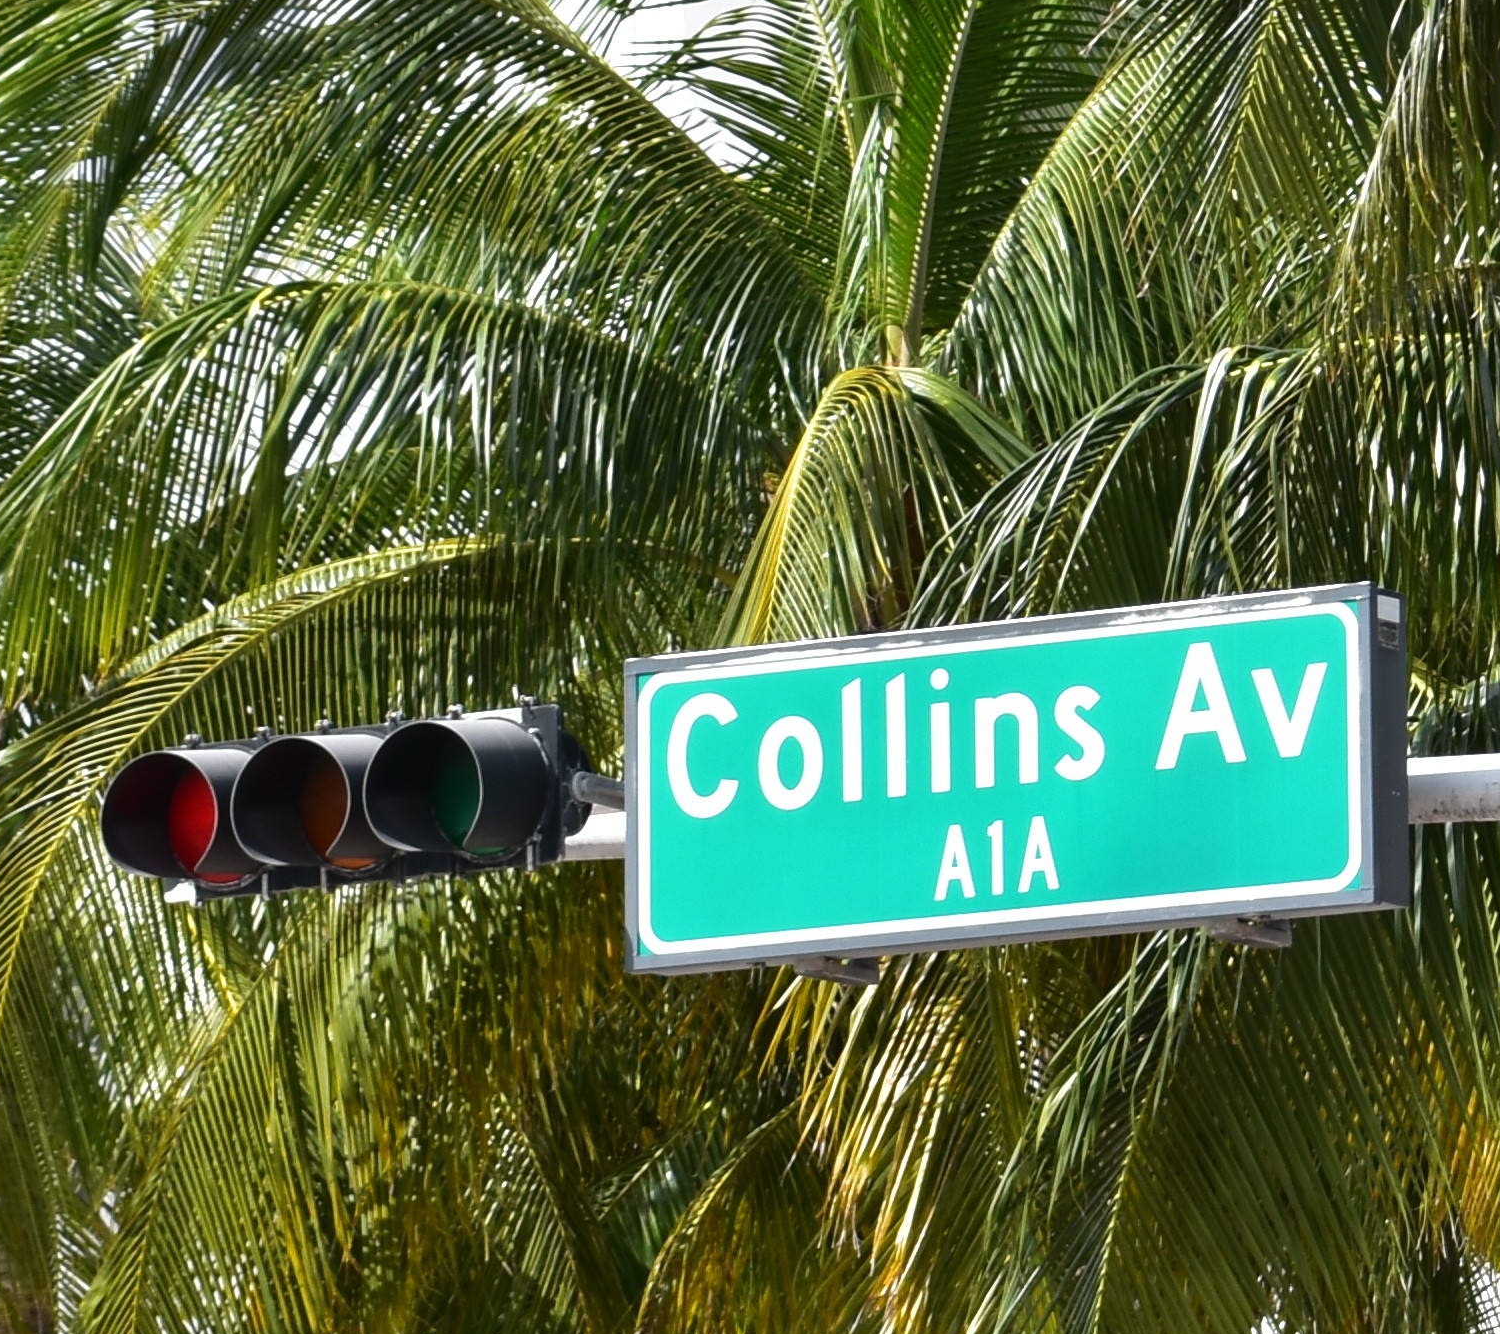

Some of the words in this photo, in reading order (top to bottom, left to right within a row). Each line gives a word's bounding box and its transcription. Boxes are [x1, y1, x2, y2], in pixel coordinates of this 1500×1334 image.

[664, 666, 1107, 820] Collins
[1154, 640, 1329, 772] Av
[933, 814, 1061, 903] A1A
